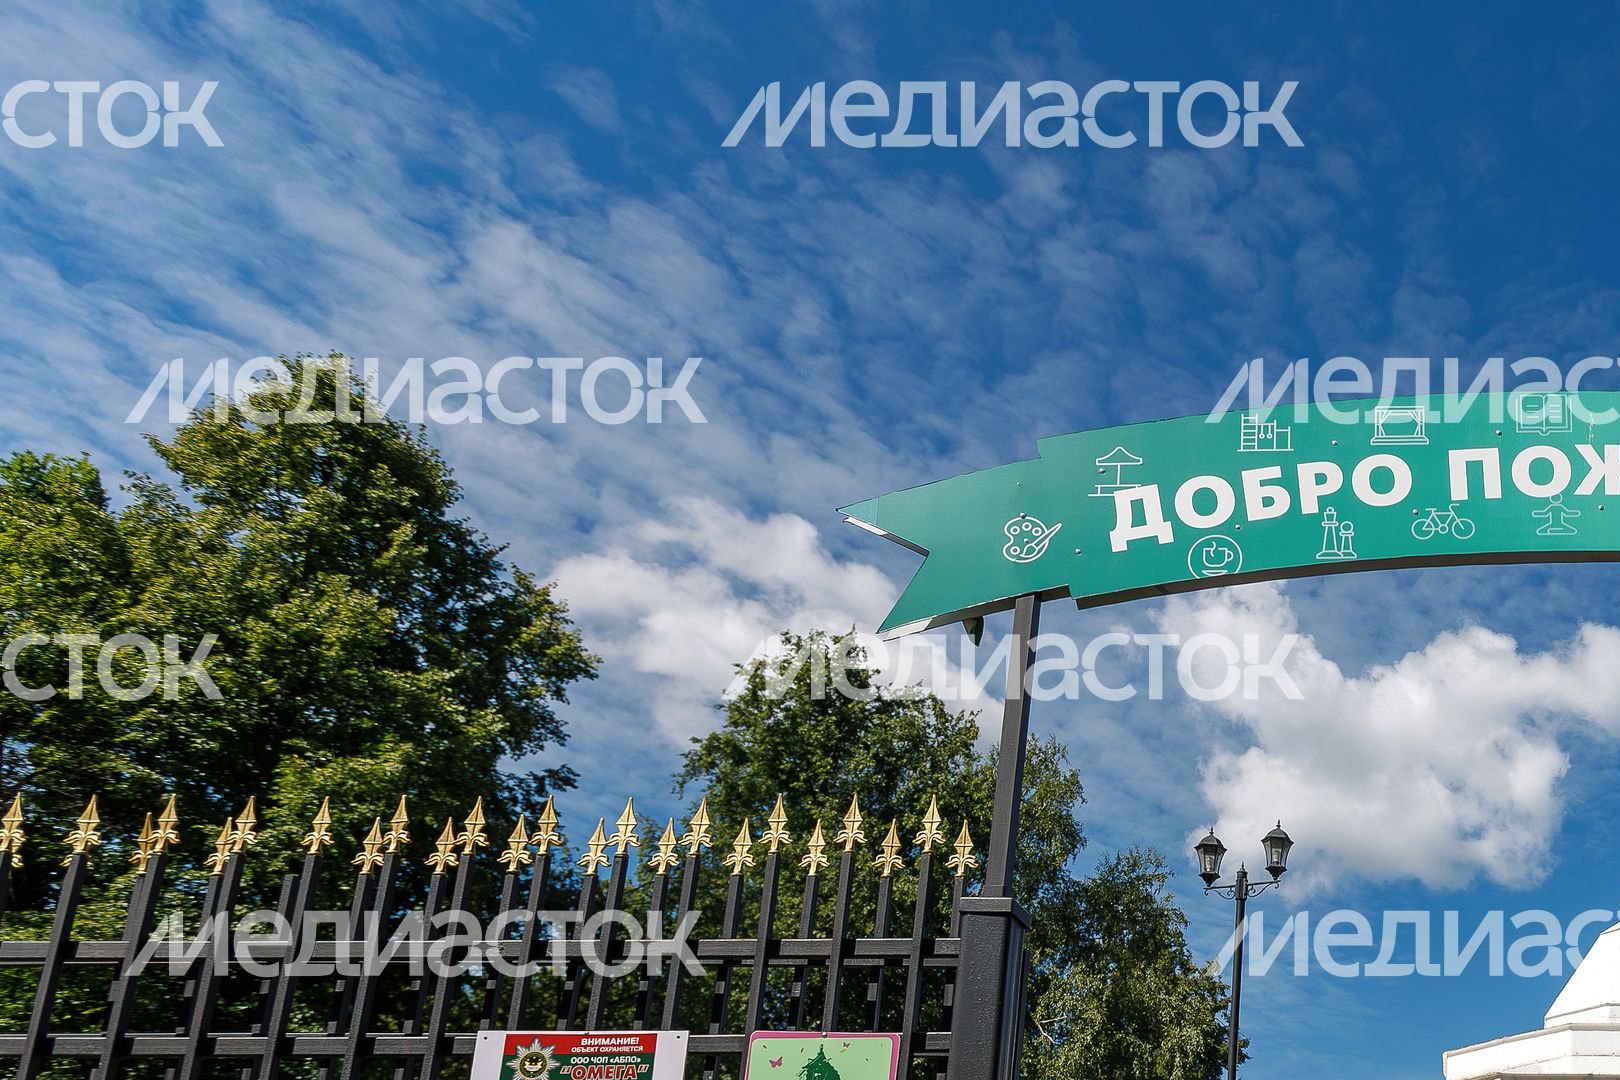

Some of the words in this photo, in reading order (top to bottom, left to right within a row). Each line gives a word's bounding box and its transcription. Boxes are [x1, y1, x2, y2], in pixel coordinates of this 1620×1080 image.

[1109, 454, 1413, 552] ДОБРО
[581, 1037, 639, 1045] ВНИМАНИЕ!
[599, 1045, 643, 1053] ОХРАНЯЕТСЯ
[570, 1056, 589, 1064] ООО
[591, 1056, 608, 1064] ЧОП
